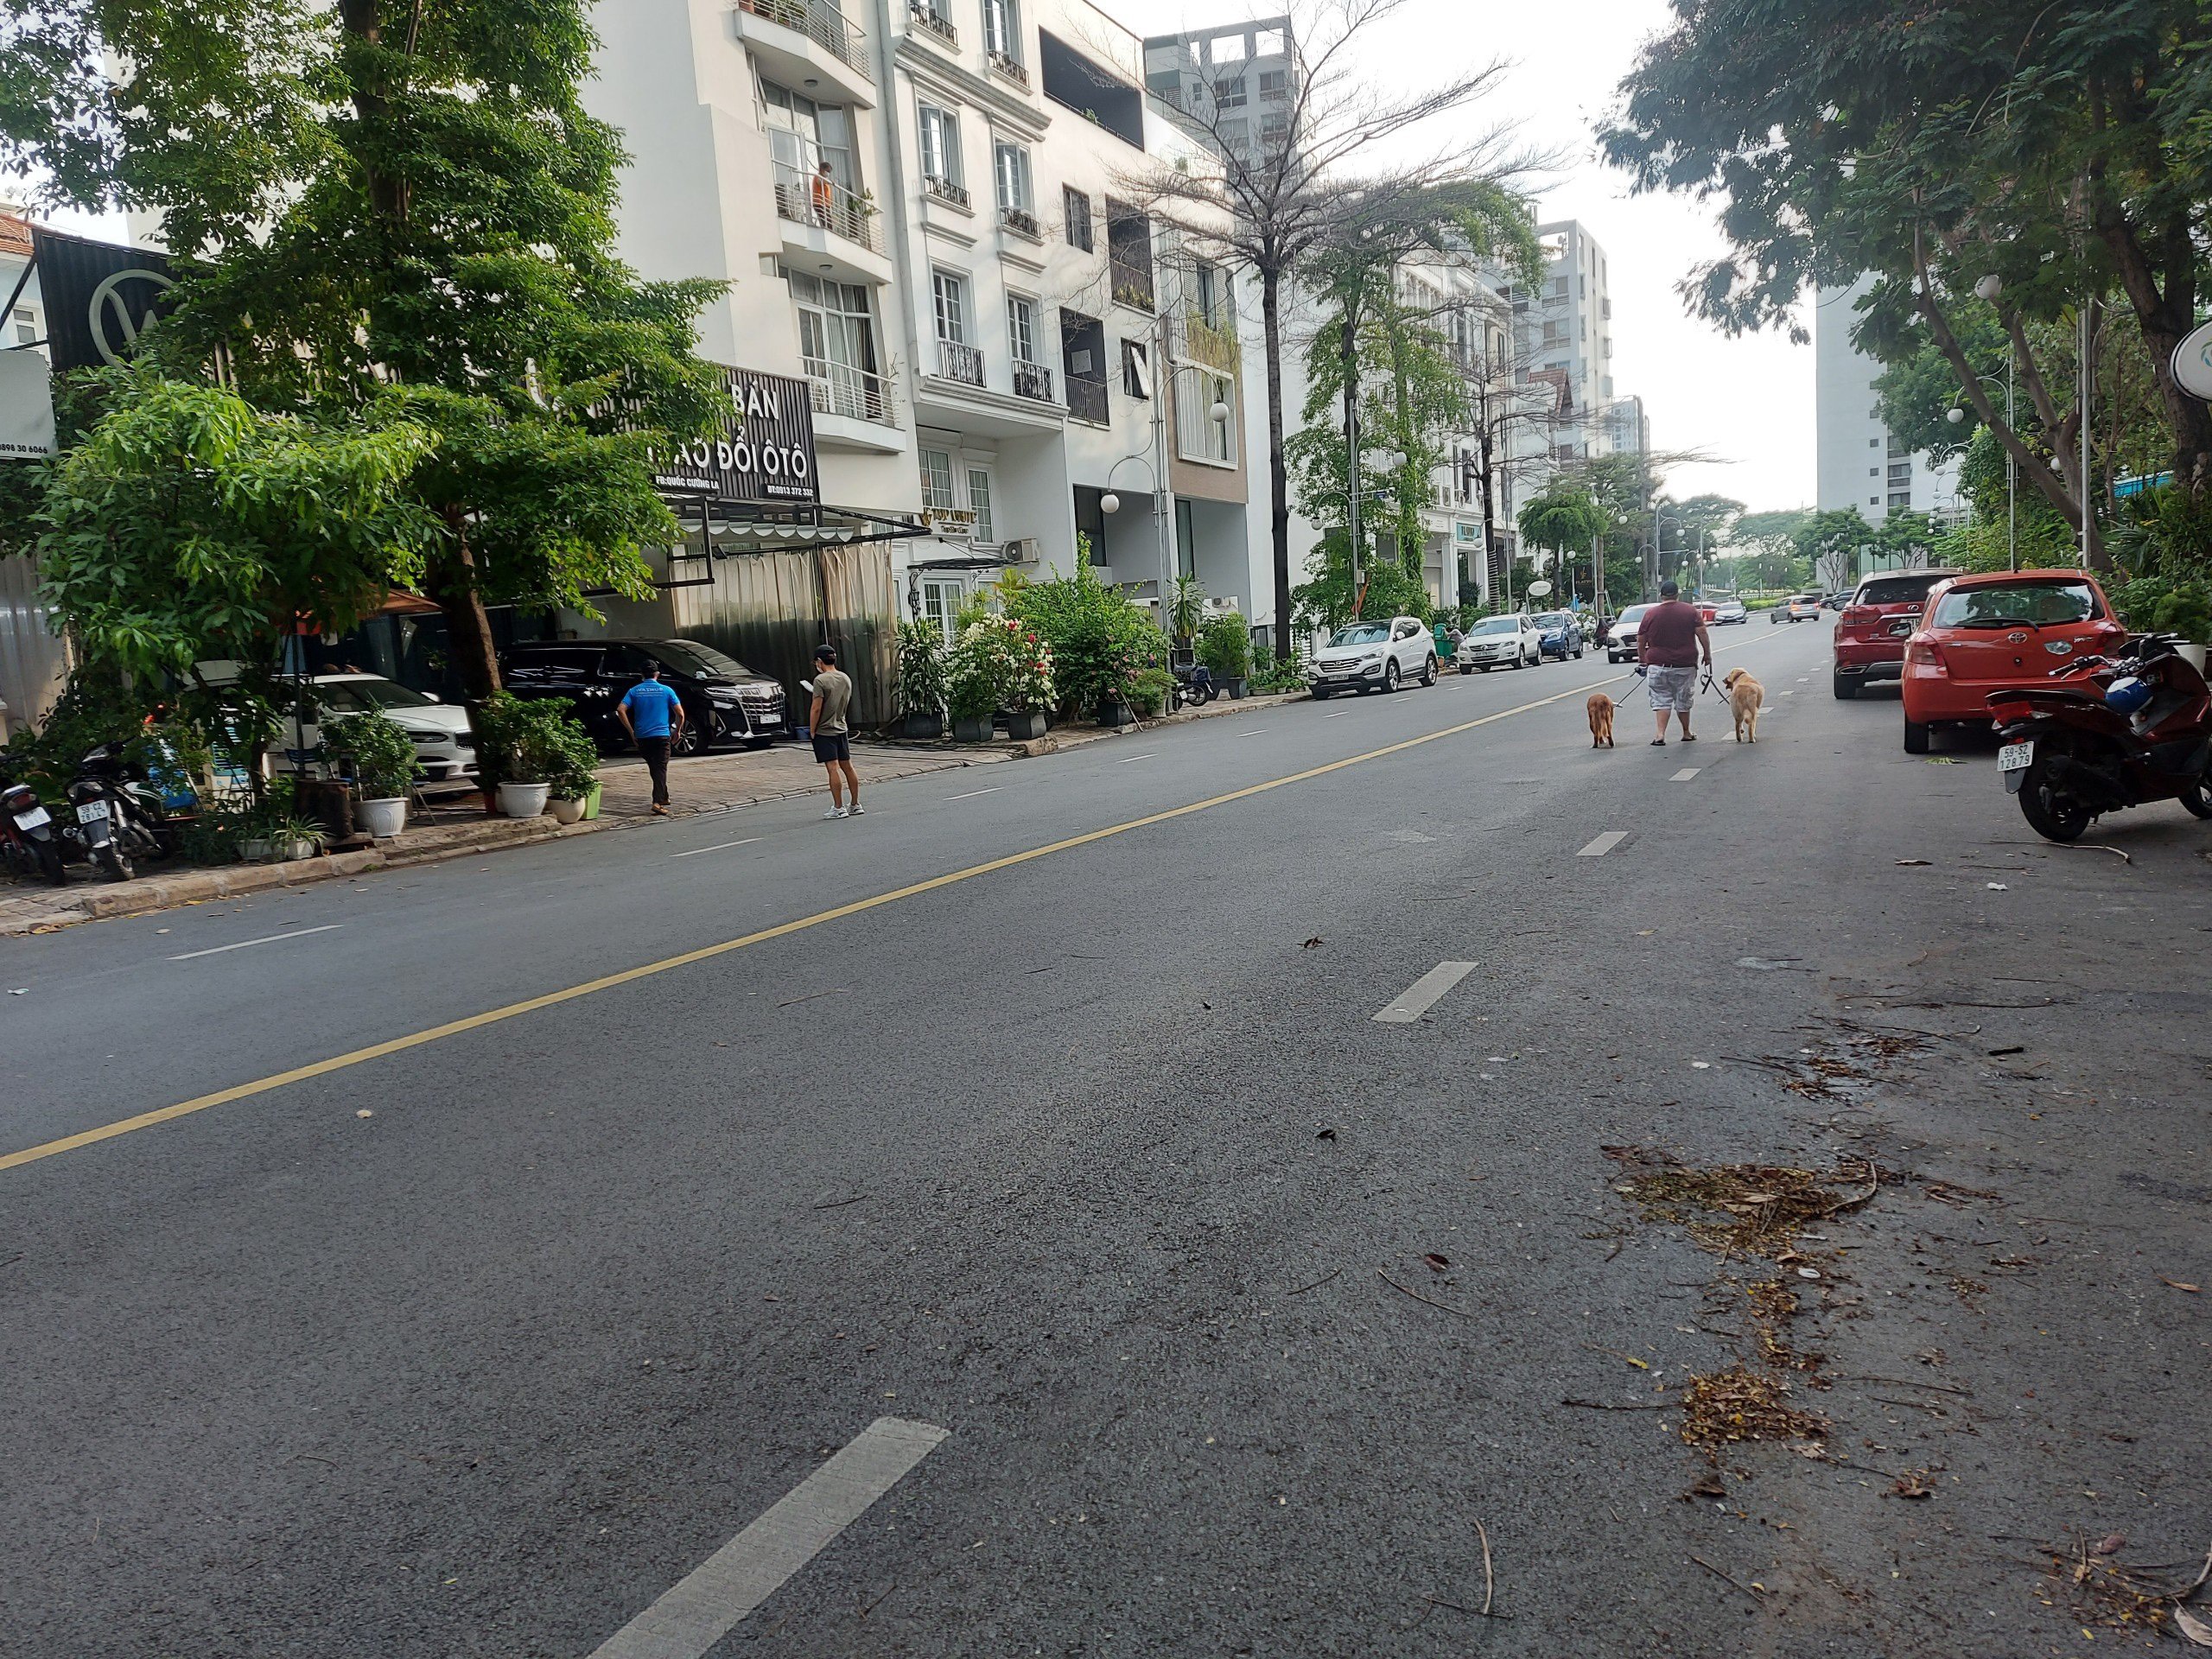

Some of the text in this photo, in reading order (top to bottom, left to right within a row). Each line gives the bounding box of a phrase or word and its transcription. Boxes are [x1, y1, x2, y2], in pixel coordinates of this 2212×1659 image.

[731, 380, 779, 420] BÁN
[0, 443, 48, 454] 898 30 6066
[716, 425, 759, 473] ĐỔI
[763, 438, 807, 479] ÔTÔ
[710, 480, 720, 489] LA
[791, 486, 803, 496] 372
[802, 487, 814, 497] 332
[2004, 744, 2029, 759] 59-S2
